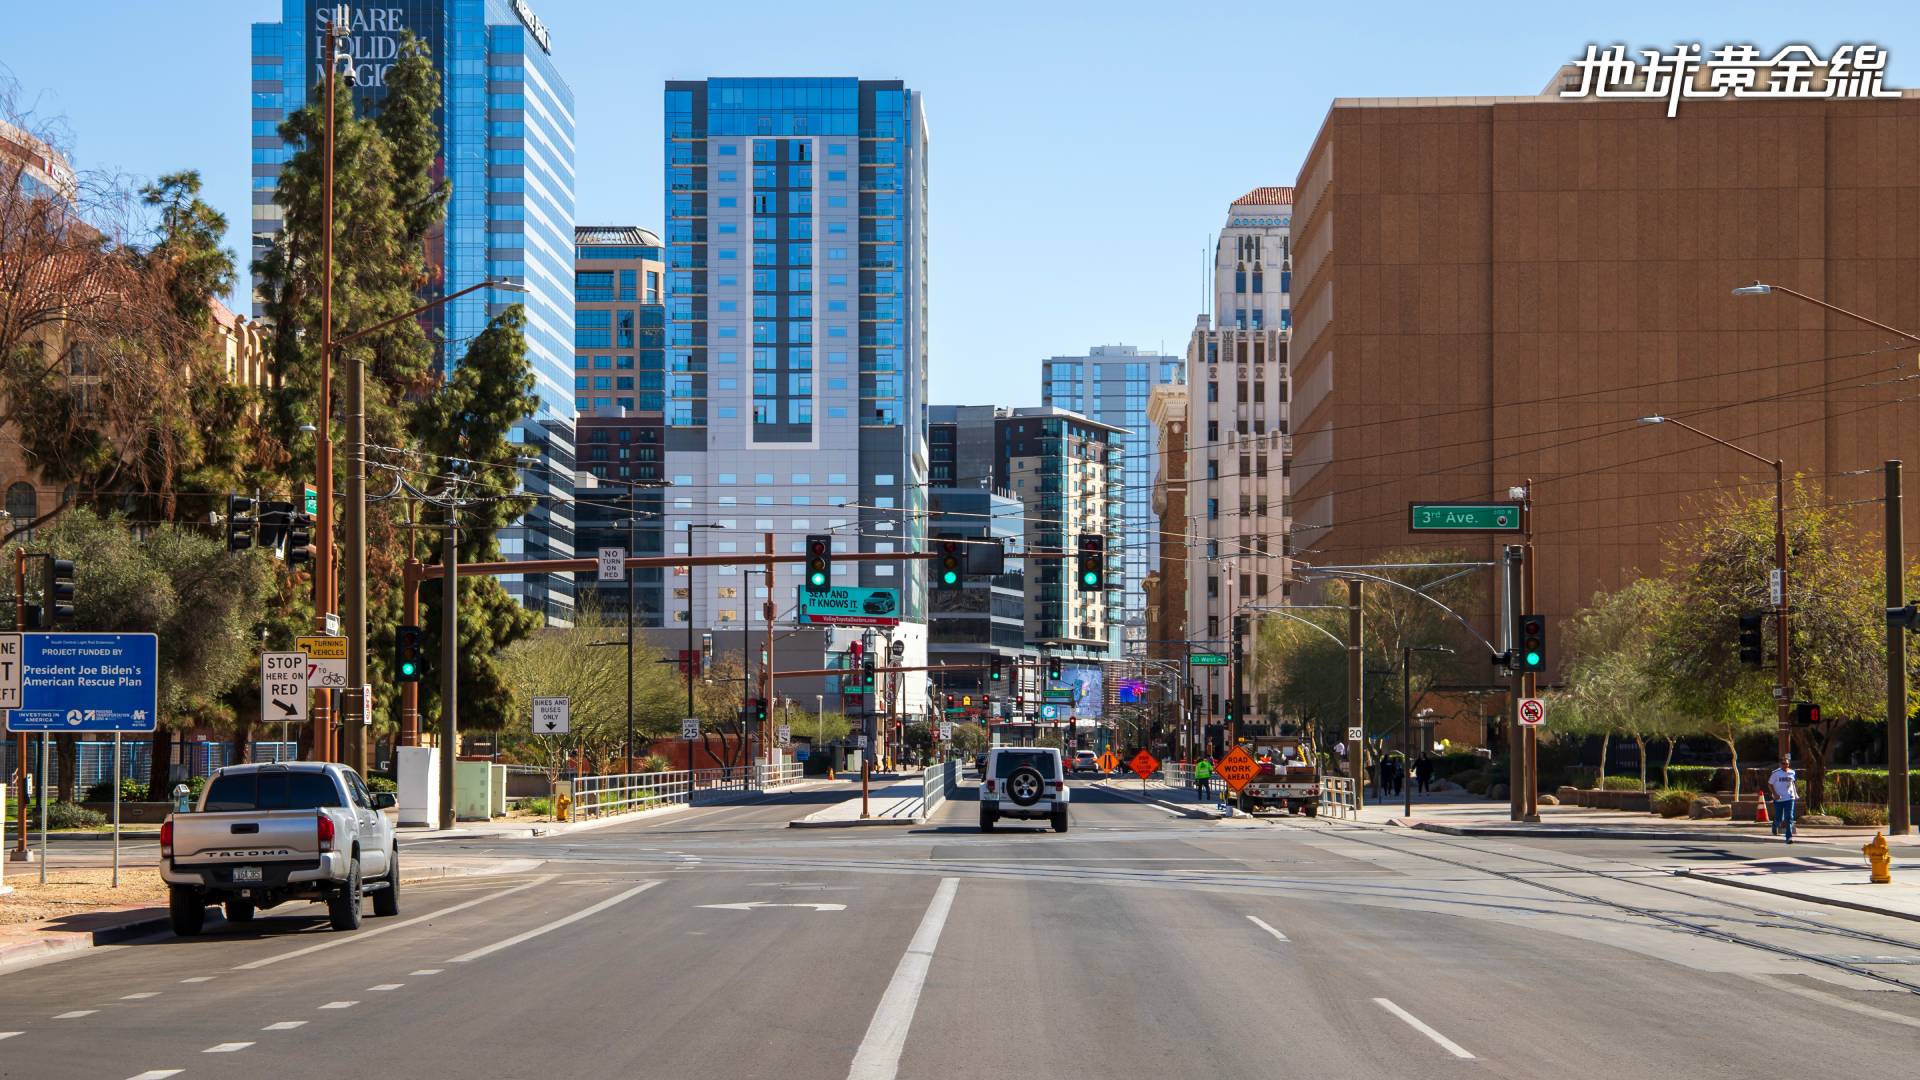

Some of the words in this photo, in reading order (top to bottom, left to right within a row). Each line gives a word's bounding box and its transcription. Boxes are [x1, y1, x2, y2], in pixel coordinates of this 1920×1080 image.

[316, 8, 403, 31] SHARE
[316, 36, 427, 59] HOLID
[316, 64, 396, 87] MGIC
[1423, 511, 1441, 523] 3rd
[1446, 512, 1479, 523] Ave.
[830, 590, 849, 599] AND
[809, 599, 817, 607] IT
[818, 600, 849, 609] KNOWS
[850, 601, 859, 609] IT.
[0, 643, 16, 654] NE
[267, 657, 302, 669] STOP
[23, 665, 75, 675] President
[79, 665, 97, 675] Joe
[101, 665, 142, 675] Biden's
[266, 672, 289, 680] HERE
[292, 672, 304, 680] ON
[23, 677, 75, 687] American
[78, 677, 115, 687] Rescue
[119, 677, 142, 687] Plan
[0, 688, 16, 700] FT
[271, 684, 298, 695] RED
[684, 728, 698, 738] 25
[1350, 729, 1361, 738] 20
